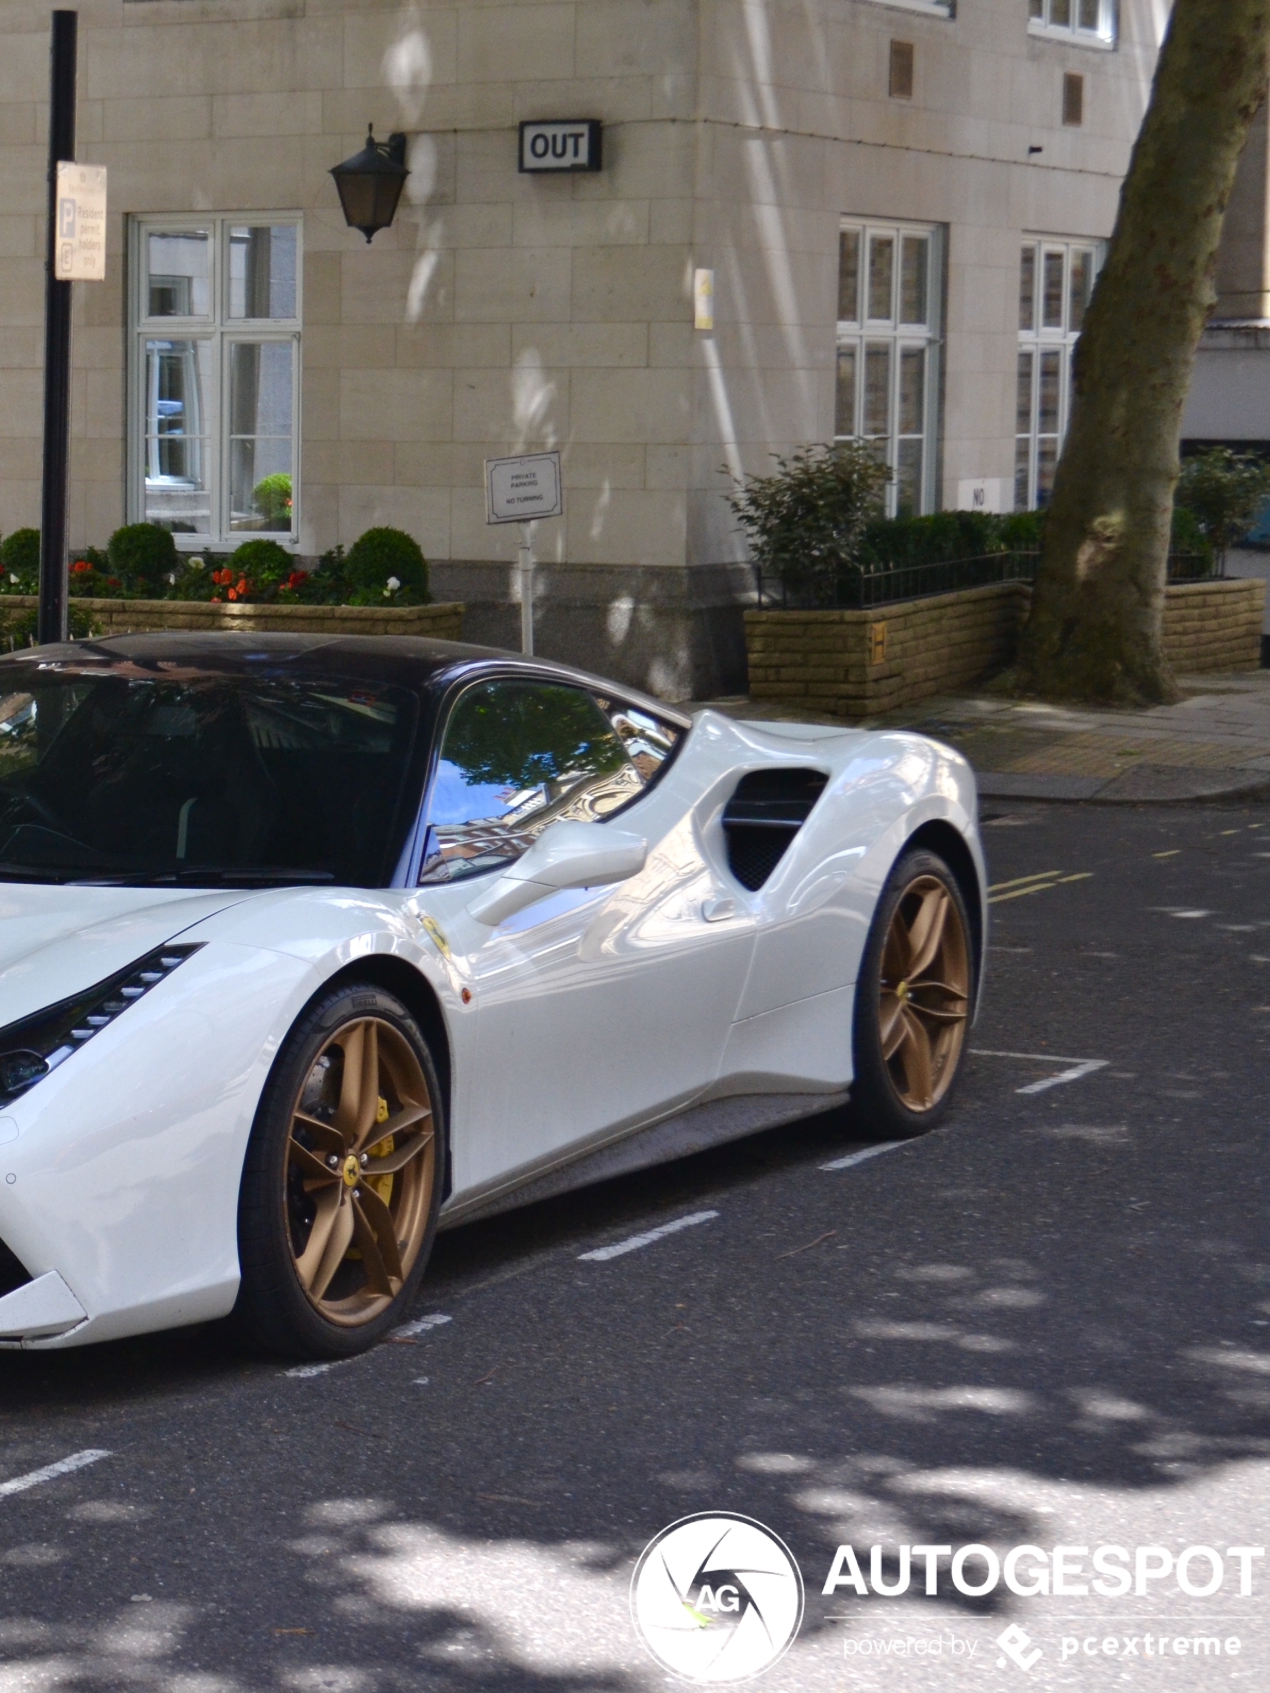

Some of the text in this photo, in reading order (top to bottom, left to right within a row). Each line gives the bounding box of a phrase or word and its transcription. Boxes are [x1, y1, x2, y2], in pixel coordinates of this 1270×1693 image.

[530, 131, 585, 159] OUT
[78, 206, 104, 219] Resident
[80, 223, 100, 236] permit
[79, 238, 101, 251] holders
[83, 255, 96, 267] only
[511, 472, 537, 481] PRIVATE
[510, 480, 538, 489] PARKING
[516, 494, 544, 503] TURNING
[973, 488, 985, 506] NO
[351, 994, 378, 1009] PIRELLI
